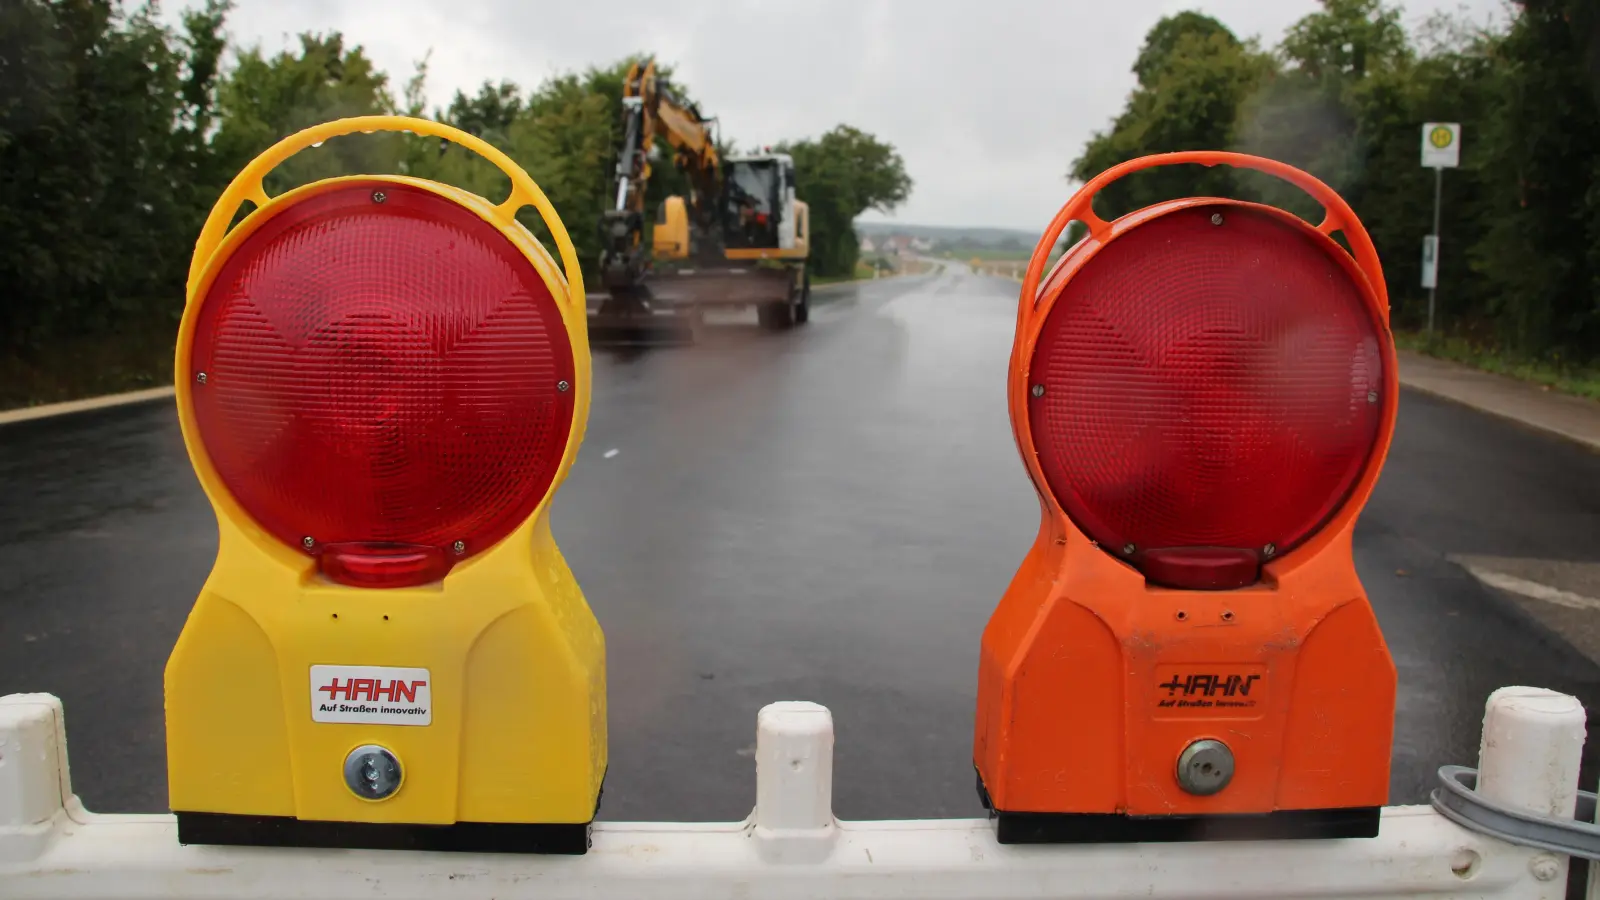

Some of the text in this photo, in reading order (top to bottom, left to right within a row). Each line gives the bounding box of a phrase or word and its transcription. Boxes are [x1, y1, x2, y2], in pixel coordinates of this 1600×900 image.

[319, 678, 427, 702] HAHN
[1159, 675, 1260, 696] HAHN
[320, 704, 426, 715] Auf Straßen innovativ
